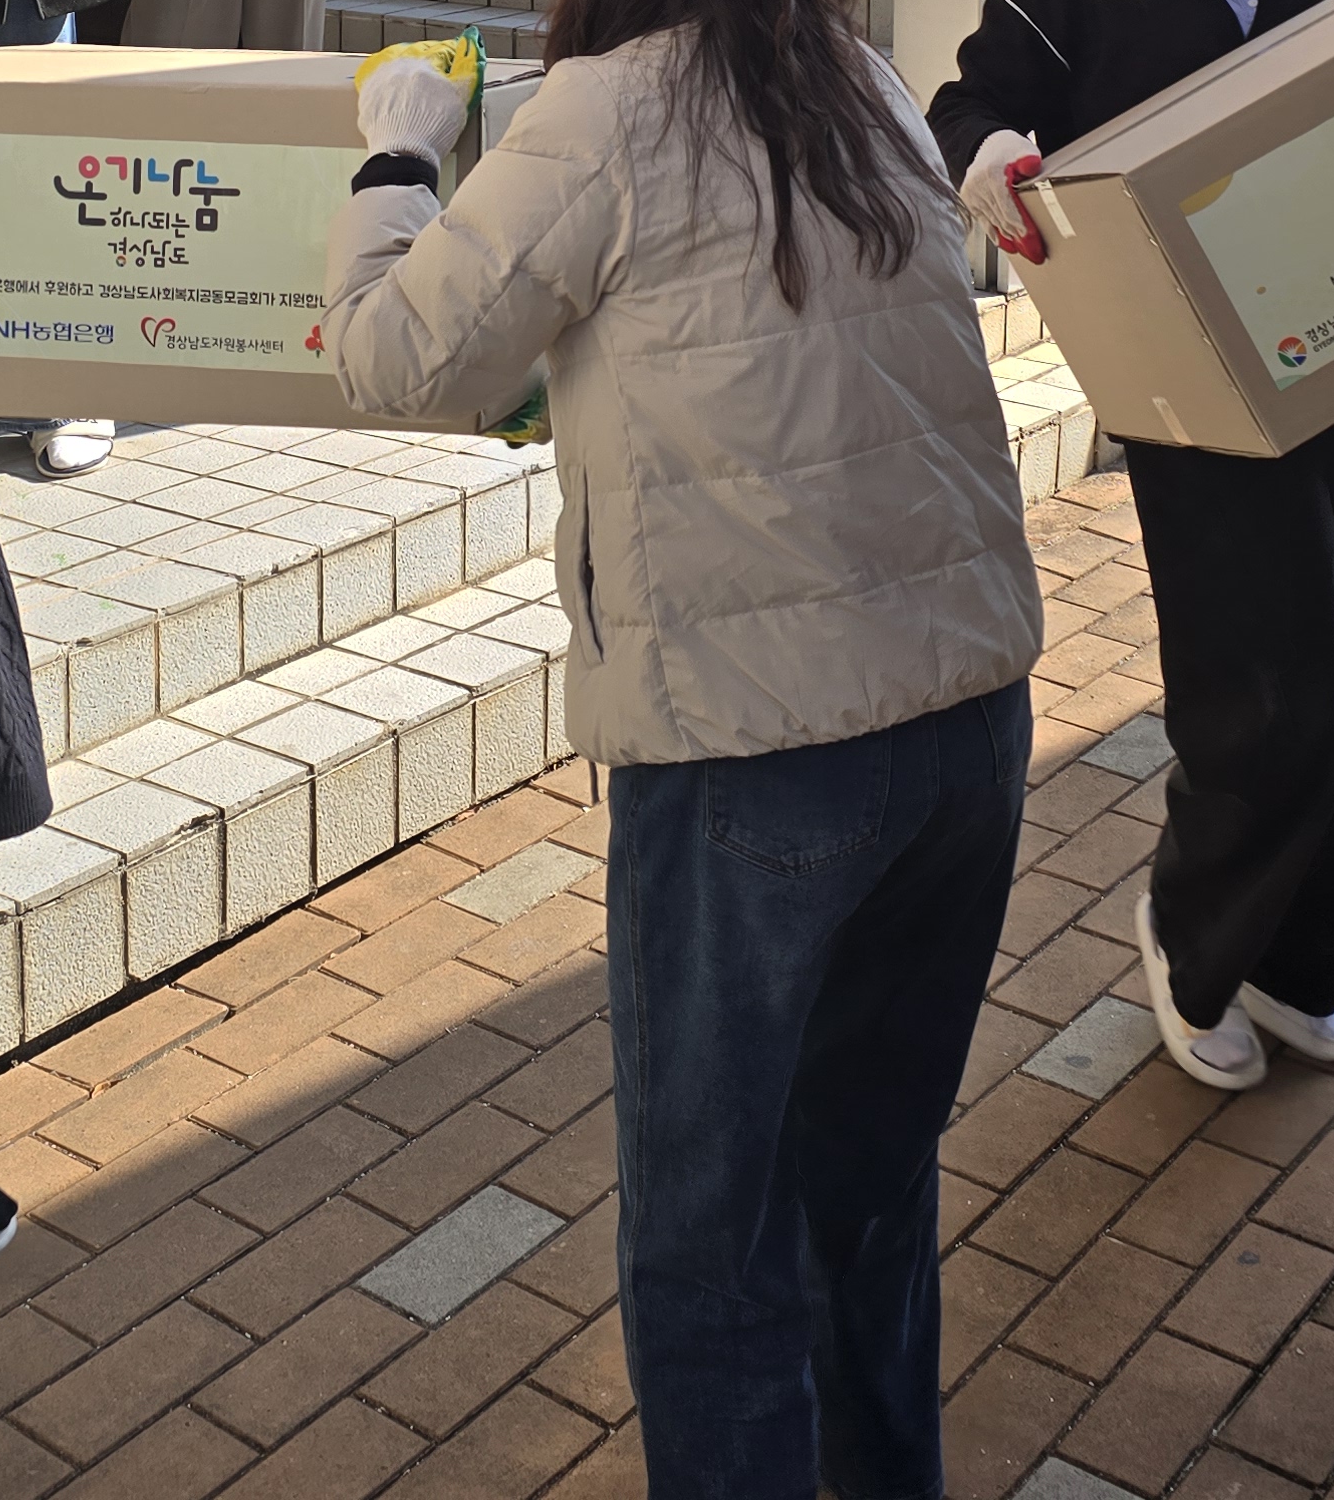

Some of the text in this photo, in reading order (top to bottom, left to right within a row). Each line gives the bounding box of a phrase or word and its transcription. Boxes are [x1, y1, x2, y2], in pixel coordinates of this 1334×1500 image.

[53, 155, 241, 233] 온기나눔
[110, 206, 190, 238] 하나되는
[108, 237, 189, 268] 경상남도
[44, 280, 94, 297] 후원하고
[98, 284, 275, 306] 경상남도사회복지공동모금회가
[165, 334, 284, 354] 경상남도자원봉사센터
